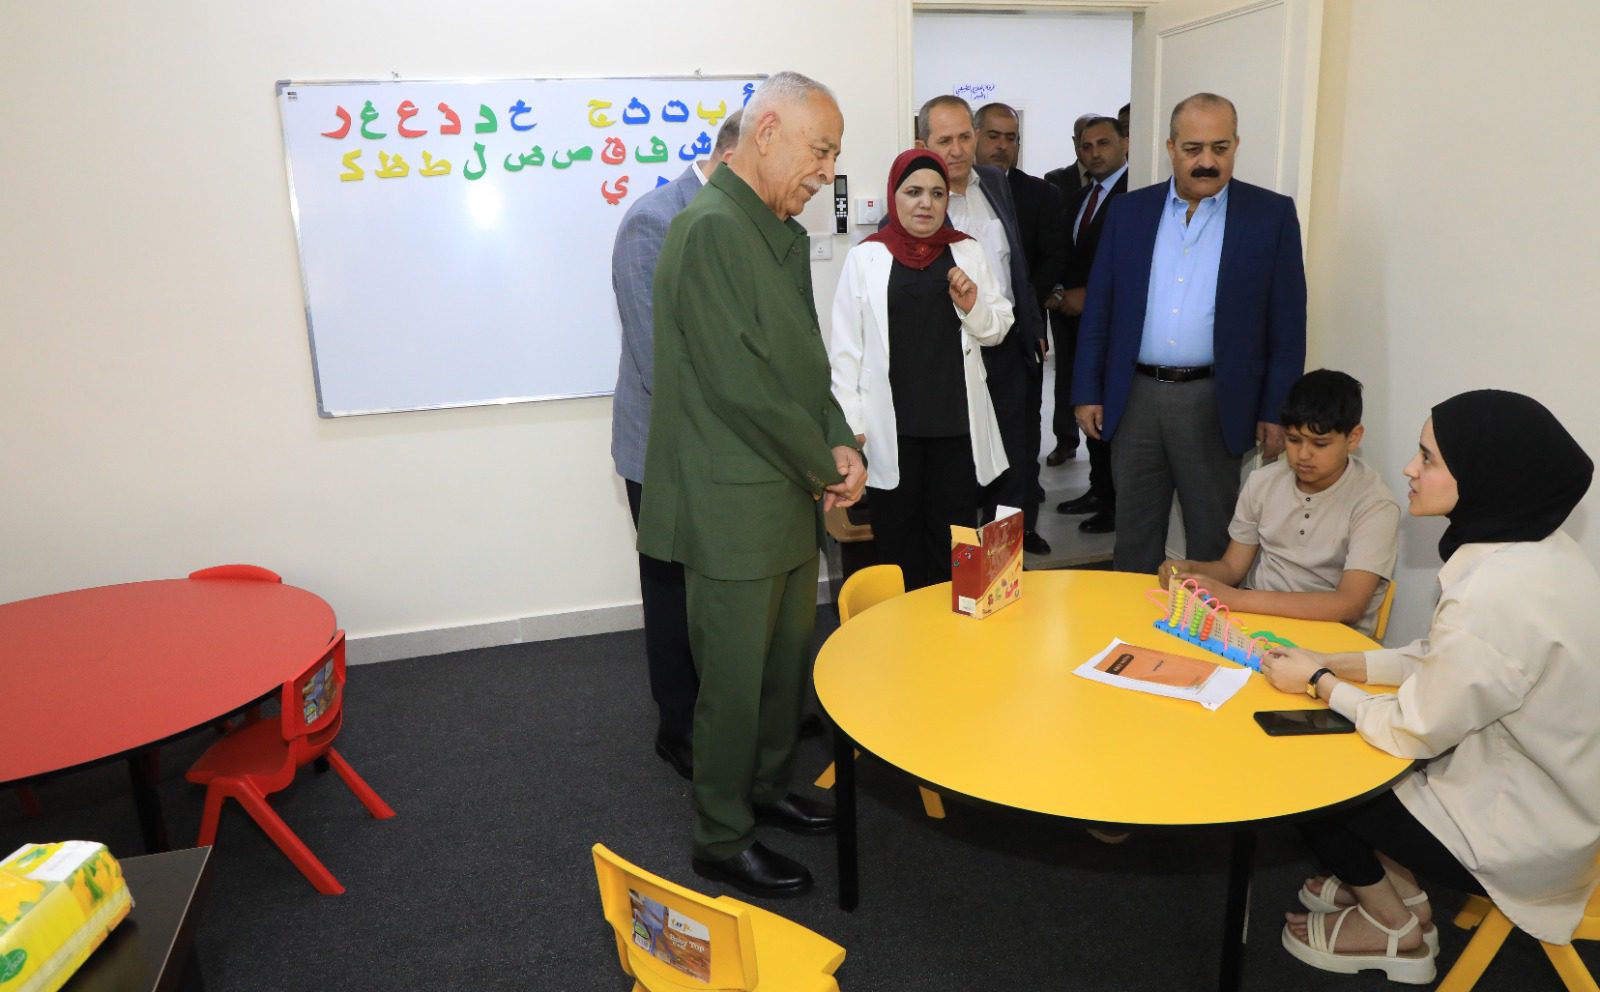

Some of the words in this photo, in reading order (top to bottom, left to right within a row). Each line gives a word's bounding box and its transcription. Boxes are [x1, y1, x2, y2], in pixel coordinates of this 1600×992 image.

[320, 105, 352, 140] ر
[360, 100, 388, 140] غ
[397, 100, 428, 139] ع
[437, 102, 462, 135] ذ
[474, 103, 498, 134] د
[508, 99, 538, 132] خ
[587, 98, 617, 128] ج
[622, 96, 651, 126] ث
[661, 99, 690, 123] ت
[696, 100, 727, 126] ب
[374, 150, 411, 179] ظ
[418, 150, 452, 178] ط
[463, 142, 488, 181] ل
[503, 145, 546, 173] ض
[551, 145, 593, 170] ص
[600, 136, 627, 166] ق
[634, 135, 669, 164] ف
[601, 174, 630, 206] ي
